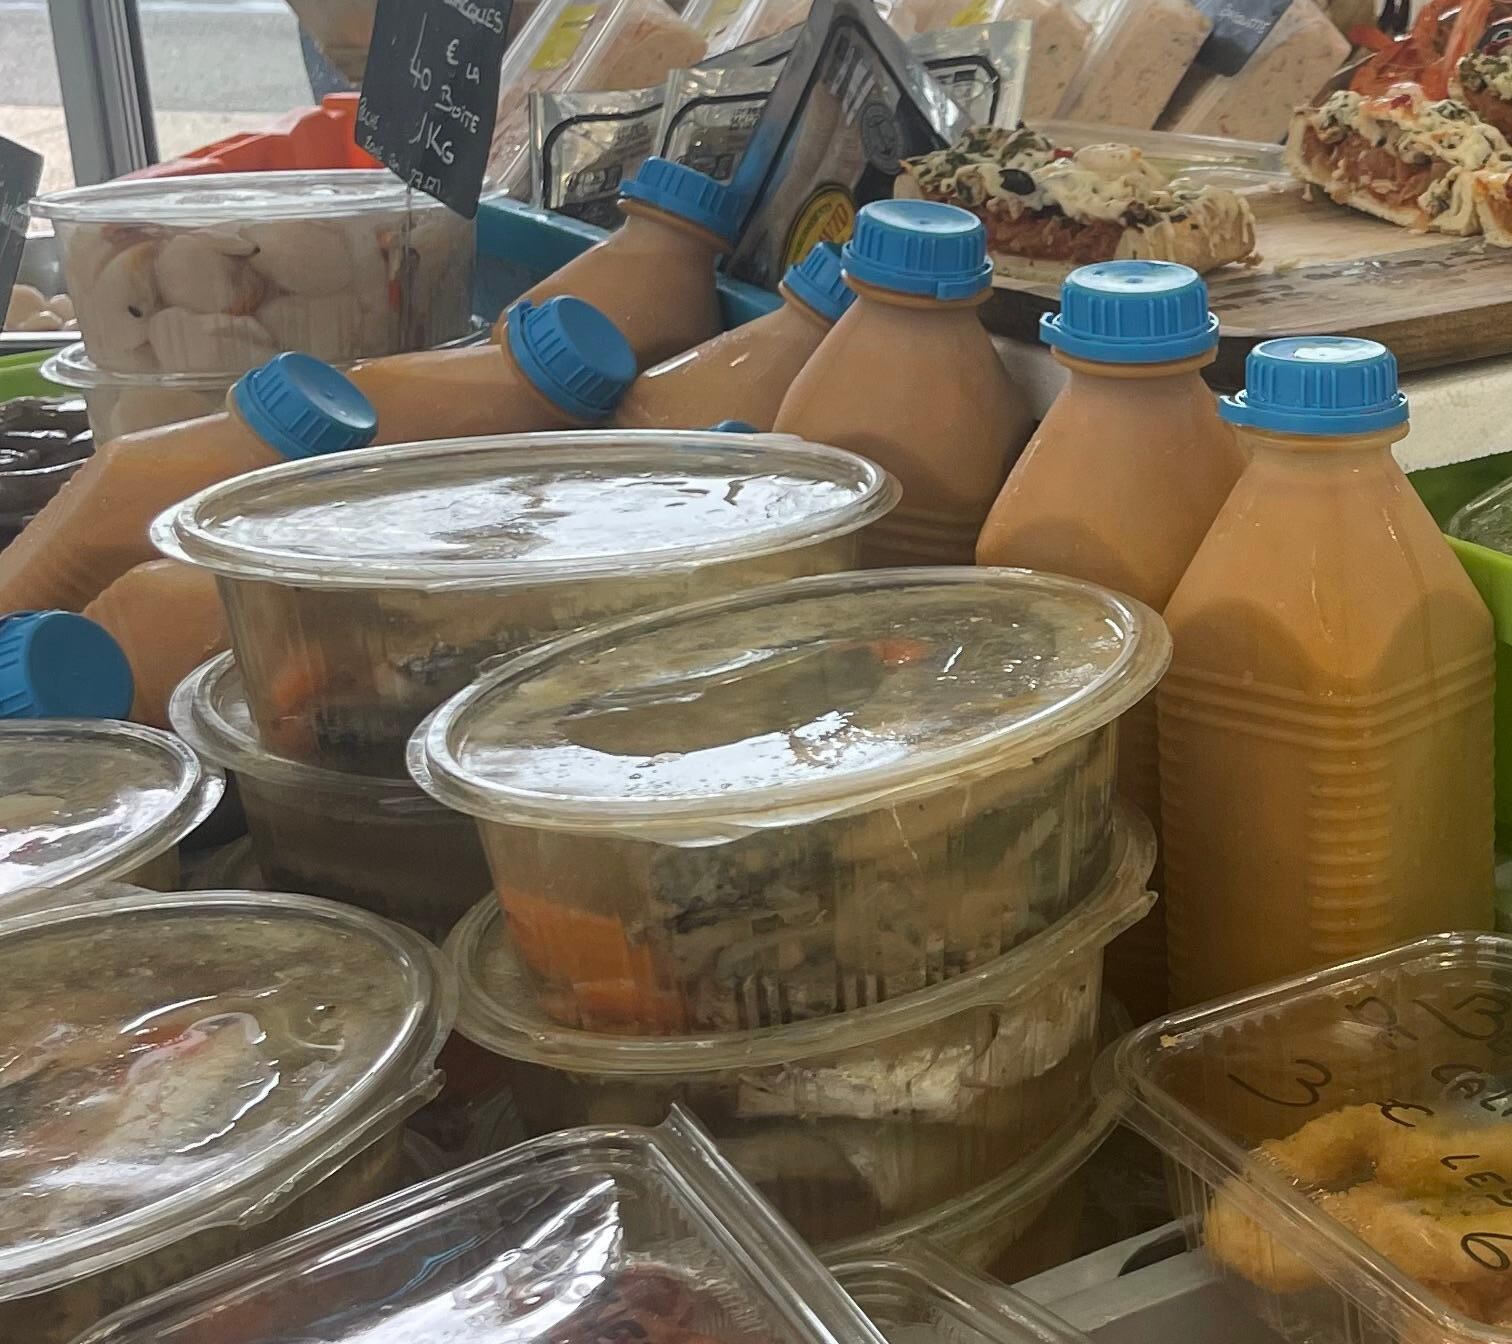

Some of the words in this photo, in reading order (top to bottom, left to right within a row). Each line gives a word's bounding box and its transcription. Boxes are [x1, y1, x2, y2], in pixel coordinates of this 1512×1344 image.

[408, 10, 433, 92] 40
[445, 38, 460, 67] €
[465, 61, 482, 86] LA
